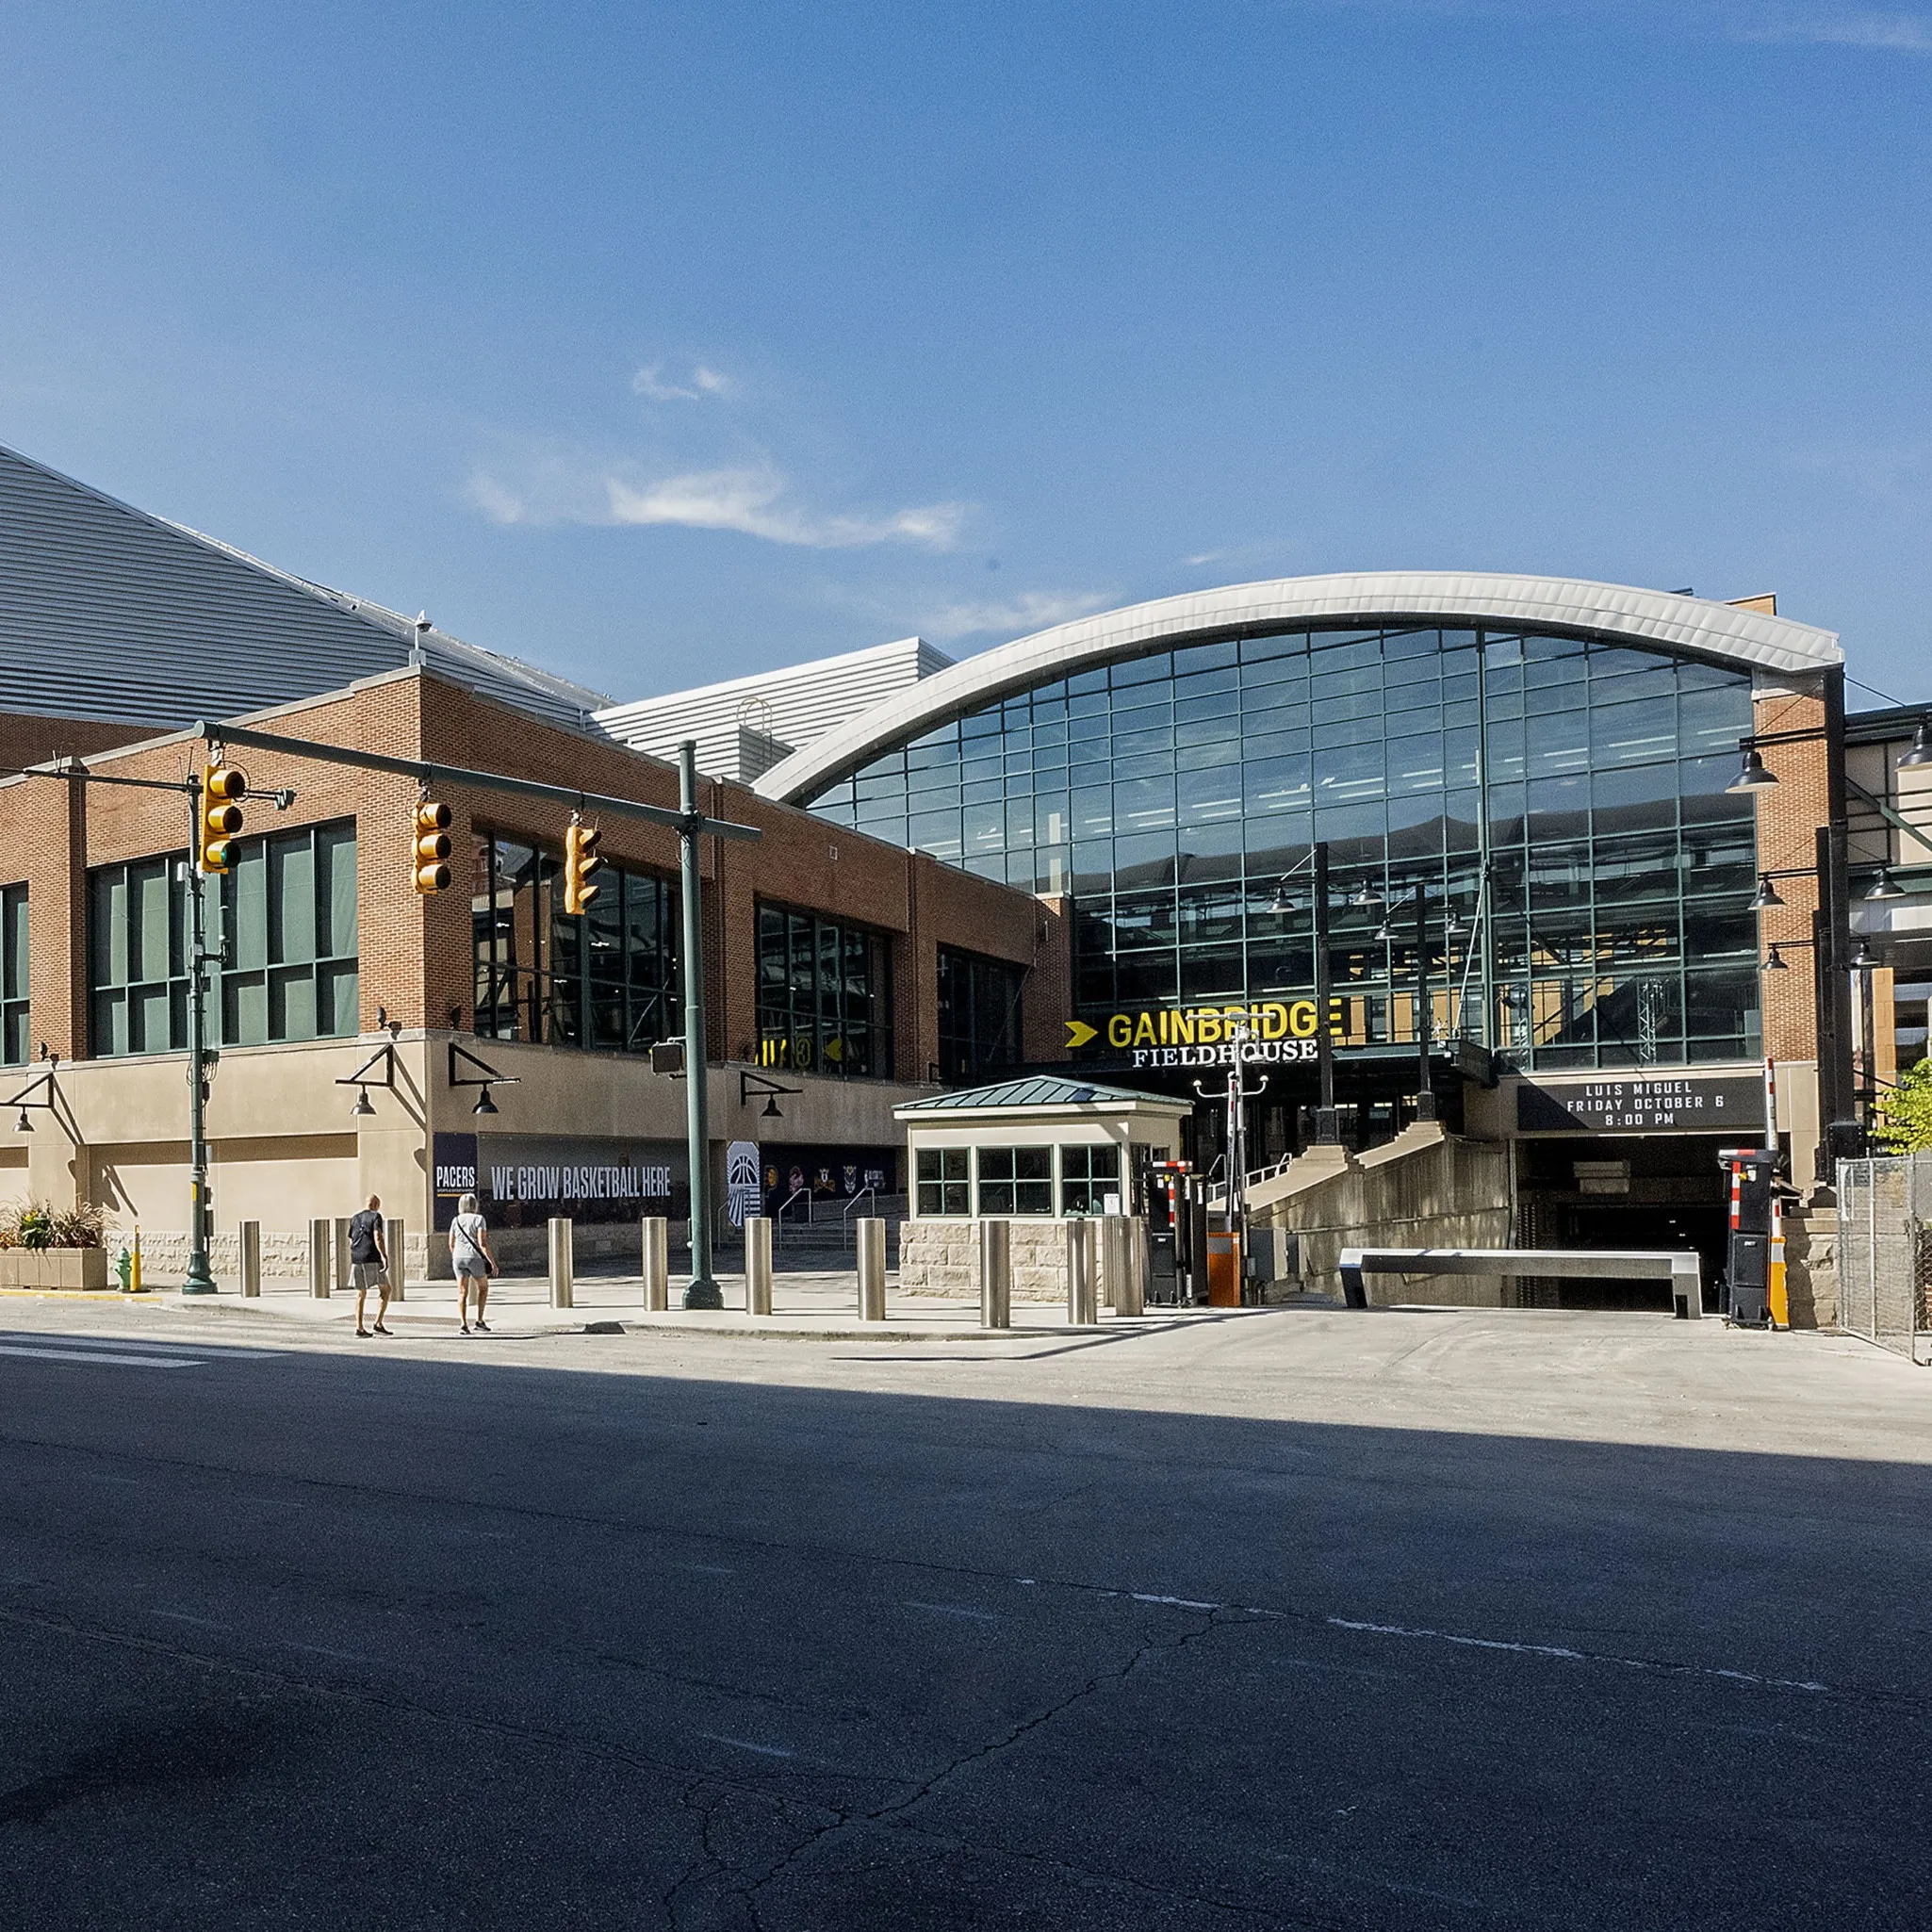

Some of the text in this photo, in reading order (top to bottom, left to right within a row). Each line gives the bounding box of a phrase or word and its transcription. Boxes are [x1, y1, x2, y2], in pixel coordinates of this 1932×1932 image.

[1132, 1039, 1318, 1068] FIELDHOUSE
[1585, 1081, 1693, 1097] LUIS MIGUEL
[1566, 1095, 1724, 1112] FRIDAY OCTOBER 6
[1605, 1112, 1674, 1126] 8:00 PM
[436, 1166, 475, 1187] PACERS
[491, 1166, 671, 1201] WE GROW BASKETBALL HERE
